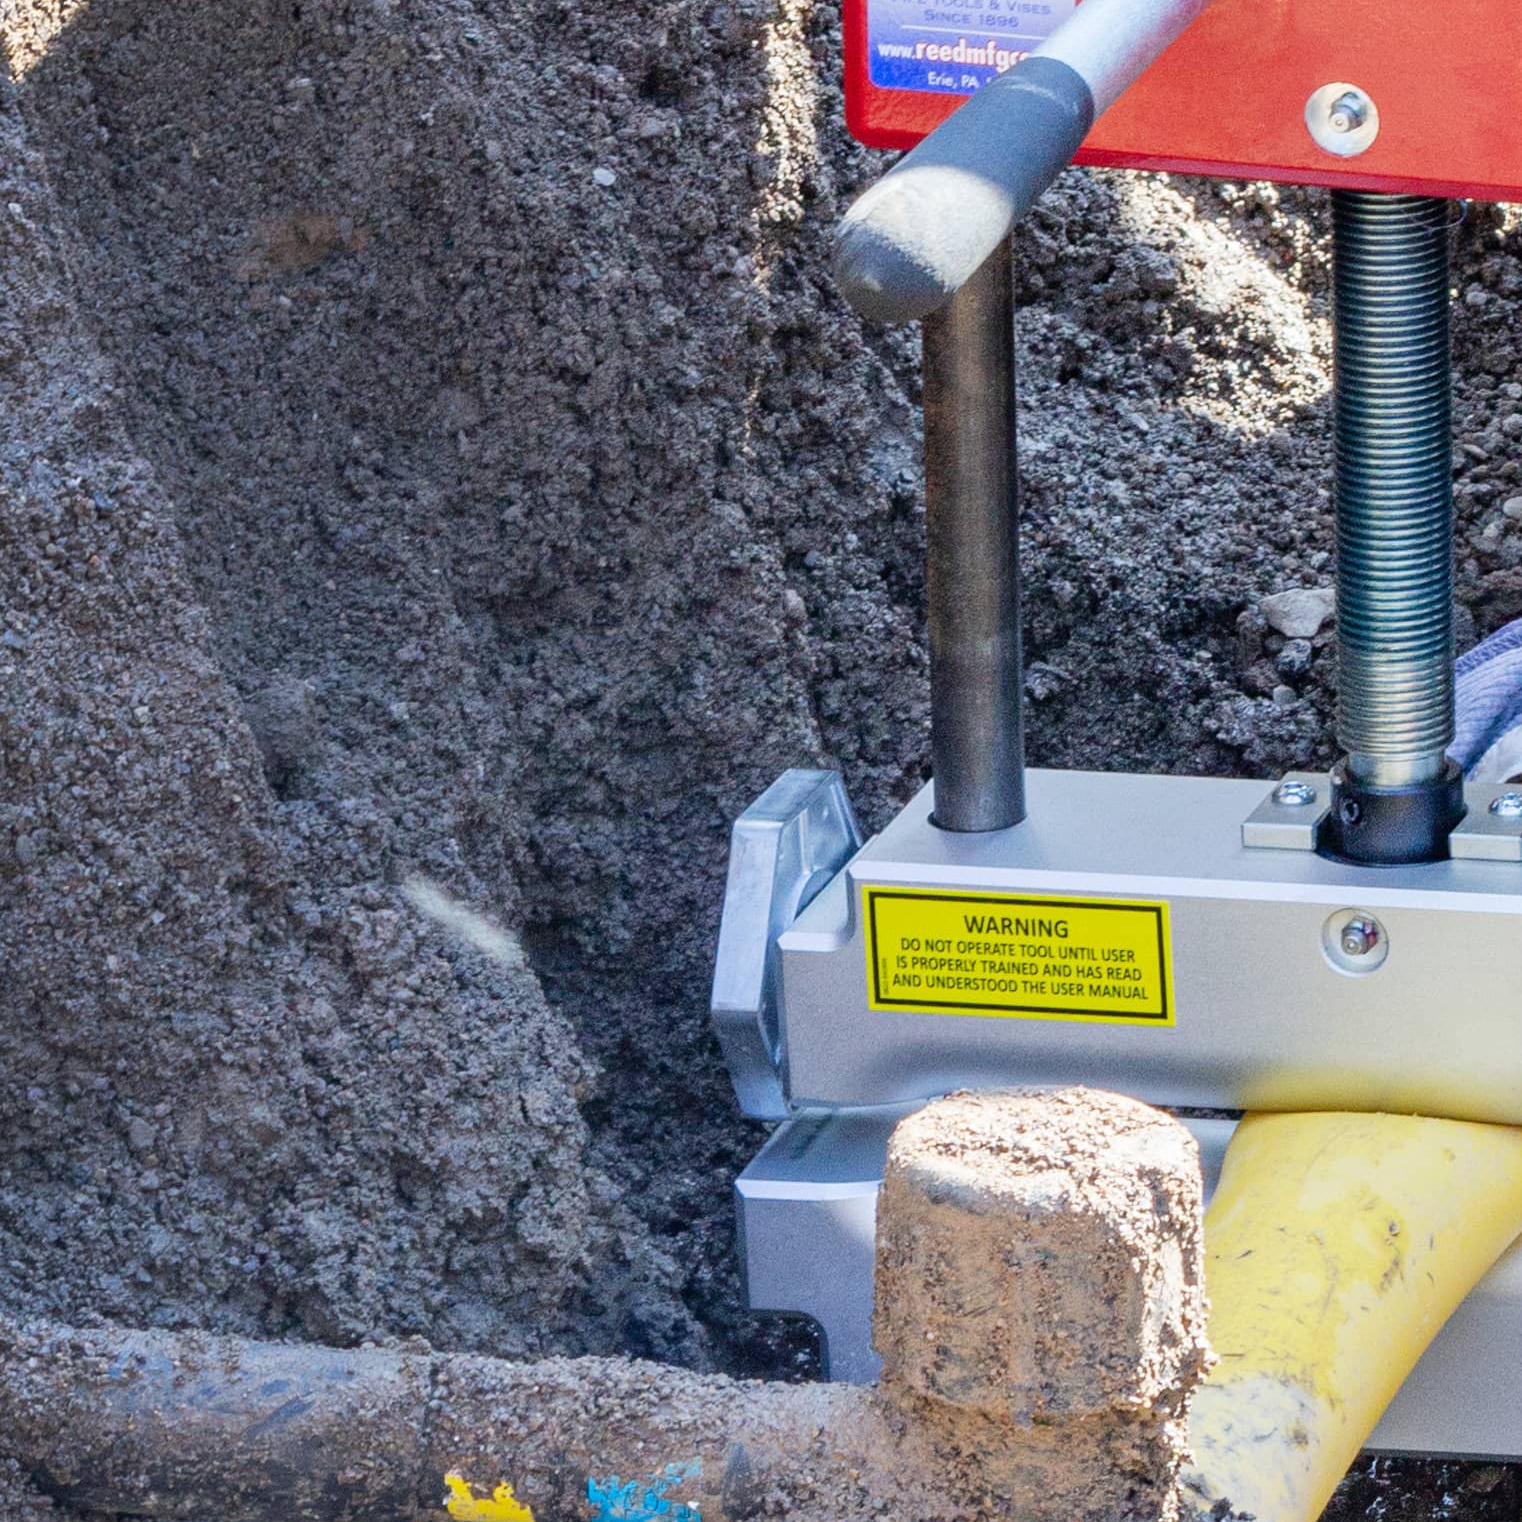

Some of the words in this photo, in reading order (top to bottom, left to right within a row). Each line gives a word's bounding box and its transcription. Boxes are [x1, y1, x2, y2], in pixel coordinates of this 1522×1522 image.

[924, 9, 971, 25] SINCE
[979, 14, 1019, 28] 1896
[989, 0, 1001, 11] &
[1006, 1, 1051, 15] VISES
[928, 71, 957, 89] Erie,
[961, 74, 979, 89] PA
[964, 915, 1069, 938] WARNING
[901, 938, 920, 952] DO
[925, 939, 952, 953] NOT
[957, 941, 1016, 957] OPERATE
[1019, 944, 1055, 959] TOOL
[1058, 946, 1098, 961] UNTIL
[1101, 949, 1135, 963] USER
[896, 955, 908, 969] IS
[912, 956, 976, 973] PROPERLY
[981, 960, 1038, 976] TRAINED
[1043, 963, 1072, 977] AND
[1076, 965, 1102, 979] HAS
[1107, 967, 1142, 981] READ
[893, 974, 921, 988] AND
[925, 975, 1018, 993] UNDERSTOOD
[1023, 980, 1047, 994] THE
[1051, 982, 1085, 996] USER
[1089, 984, 1149, 1000] MANUAL
